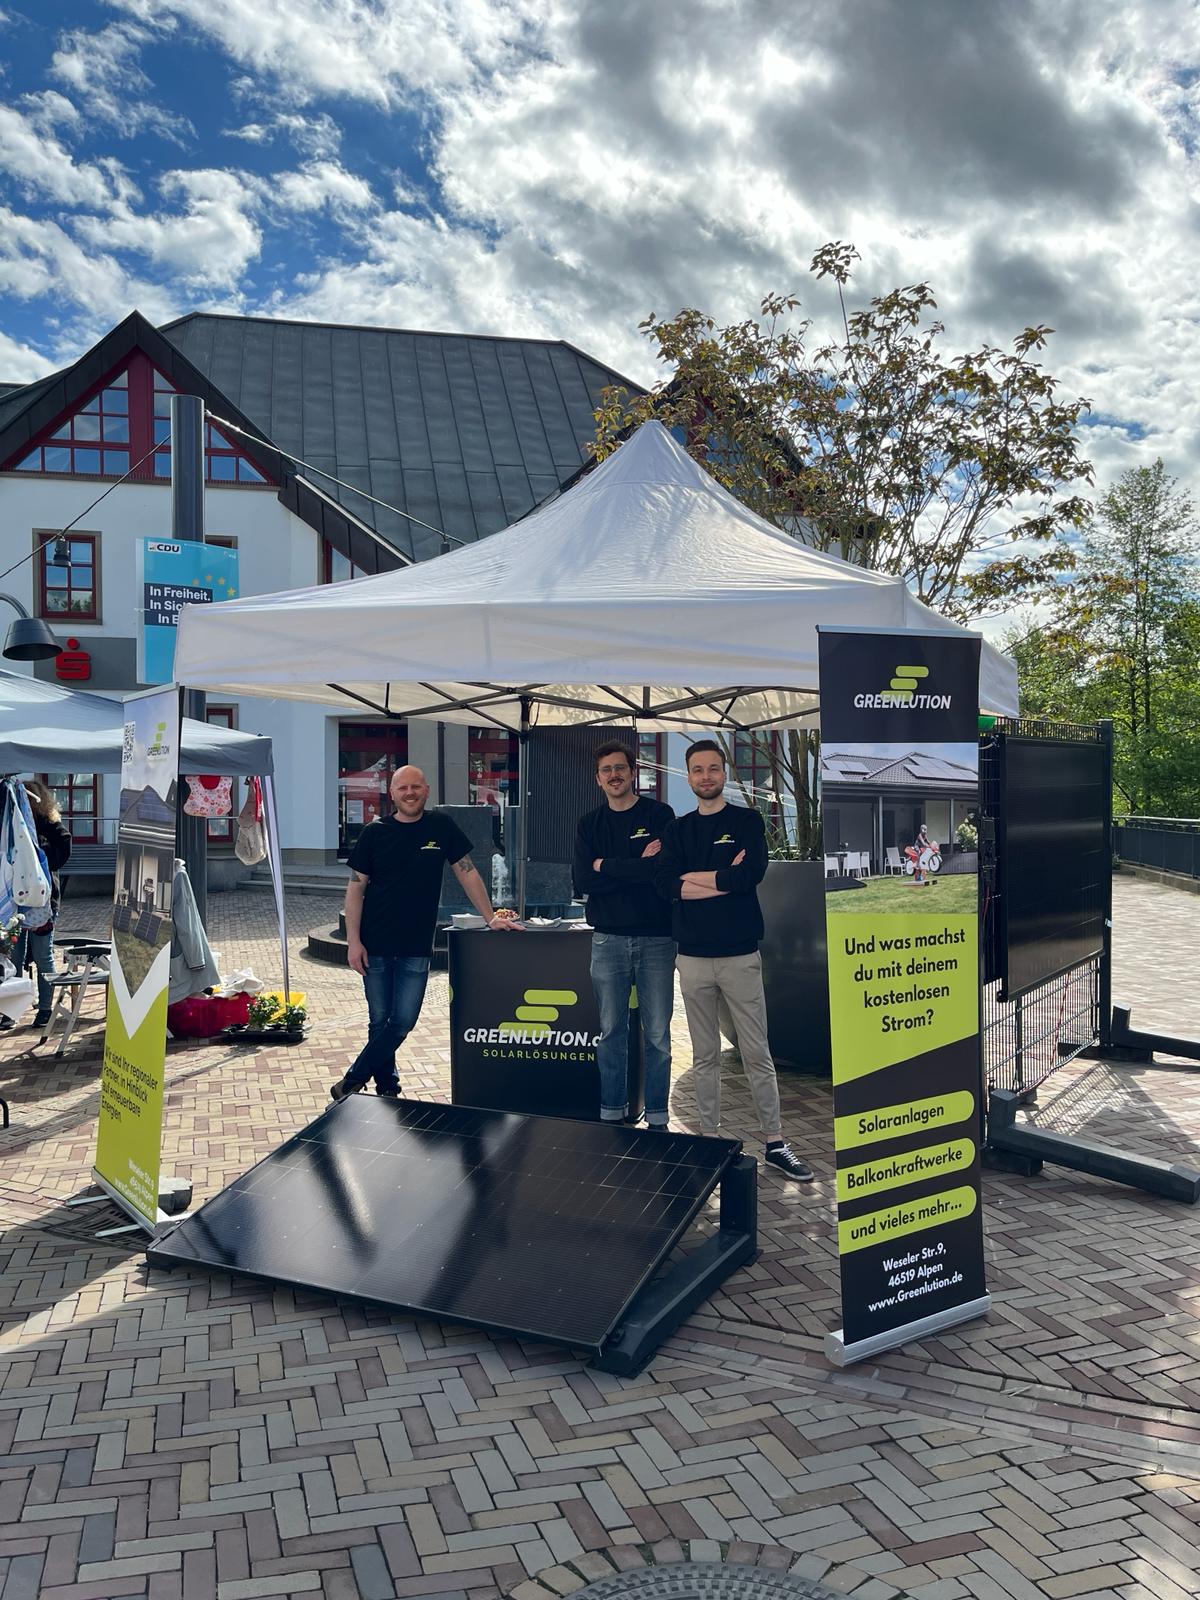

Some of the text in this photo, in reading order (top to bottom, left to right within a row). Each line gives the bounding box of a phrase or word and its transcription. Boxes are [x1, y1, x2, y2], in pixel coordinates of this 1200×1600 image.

[157, 544, 180, 552] CDU
[150, 586, 211, 601] In Freiheit.
[150, 599, 161, 610] In
[158, 613, 170, 624] In
[854, 693, 951, 710] GREENLUTION
[845, 928, 965, 955] Und was machst
[854, 957, 958, 982] du mit deinem
[864, 984, 950, 1008] kostenlosen
[881, 1008, 934, 1032] Strom?
[463, 1028, 603, 1048] GREENLUTION.d
[482, 1049, 595, 1062] SOLARLÖSUNGEN
[858, 1105, 944, 1135] Solaranlagen
[847, 1147, 963, 1189] Balkonkraftwerke
[851, 1199, 962, 1240] und vieles mehr...
[883, 1243, 947, 1272] Weseler Str.9,
[888, 1262, 943, 1288] 46519 Alpen
[868, 1271, 963, 1312] www.Greenlution.de
